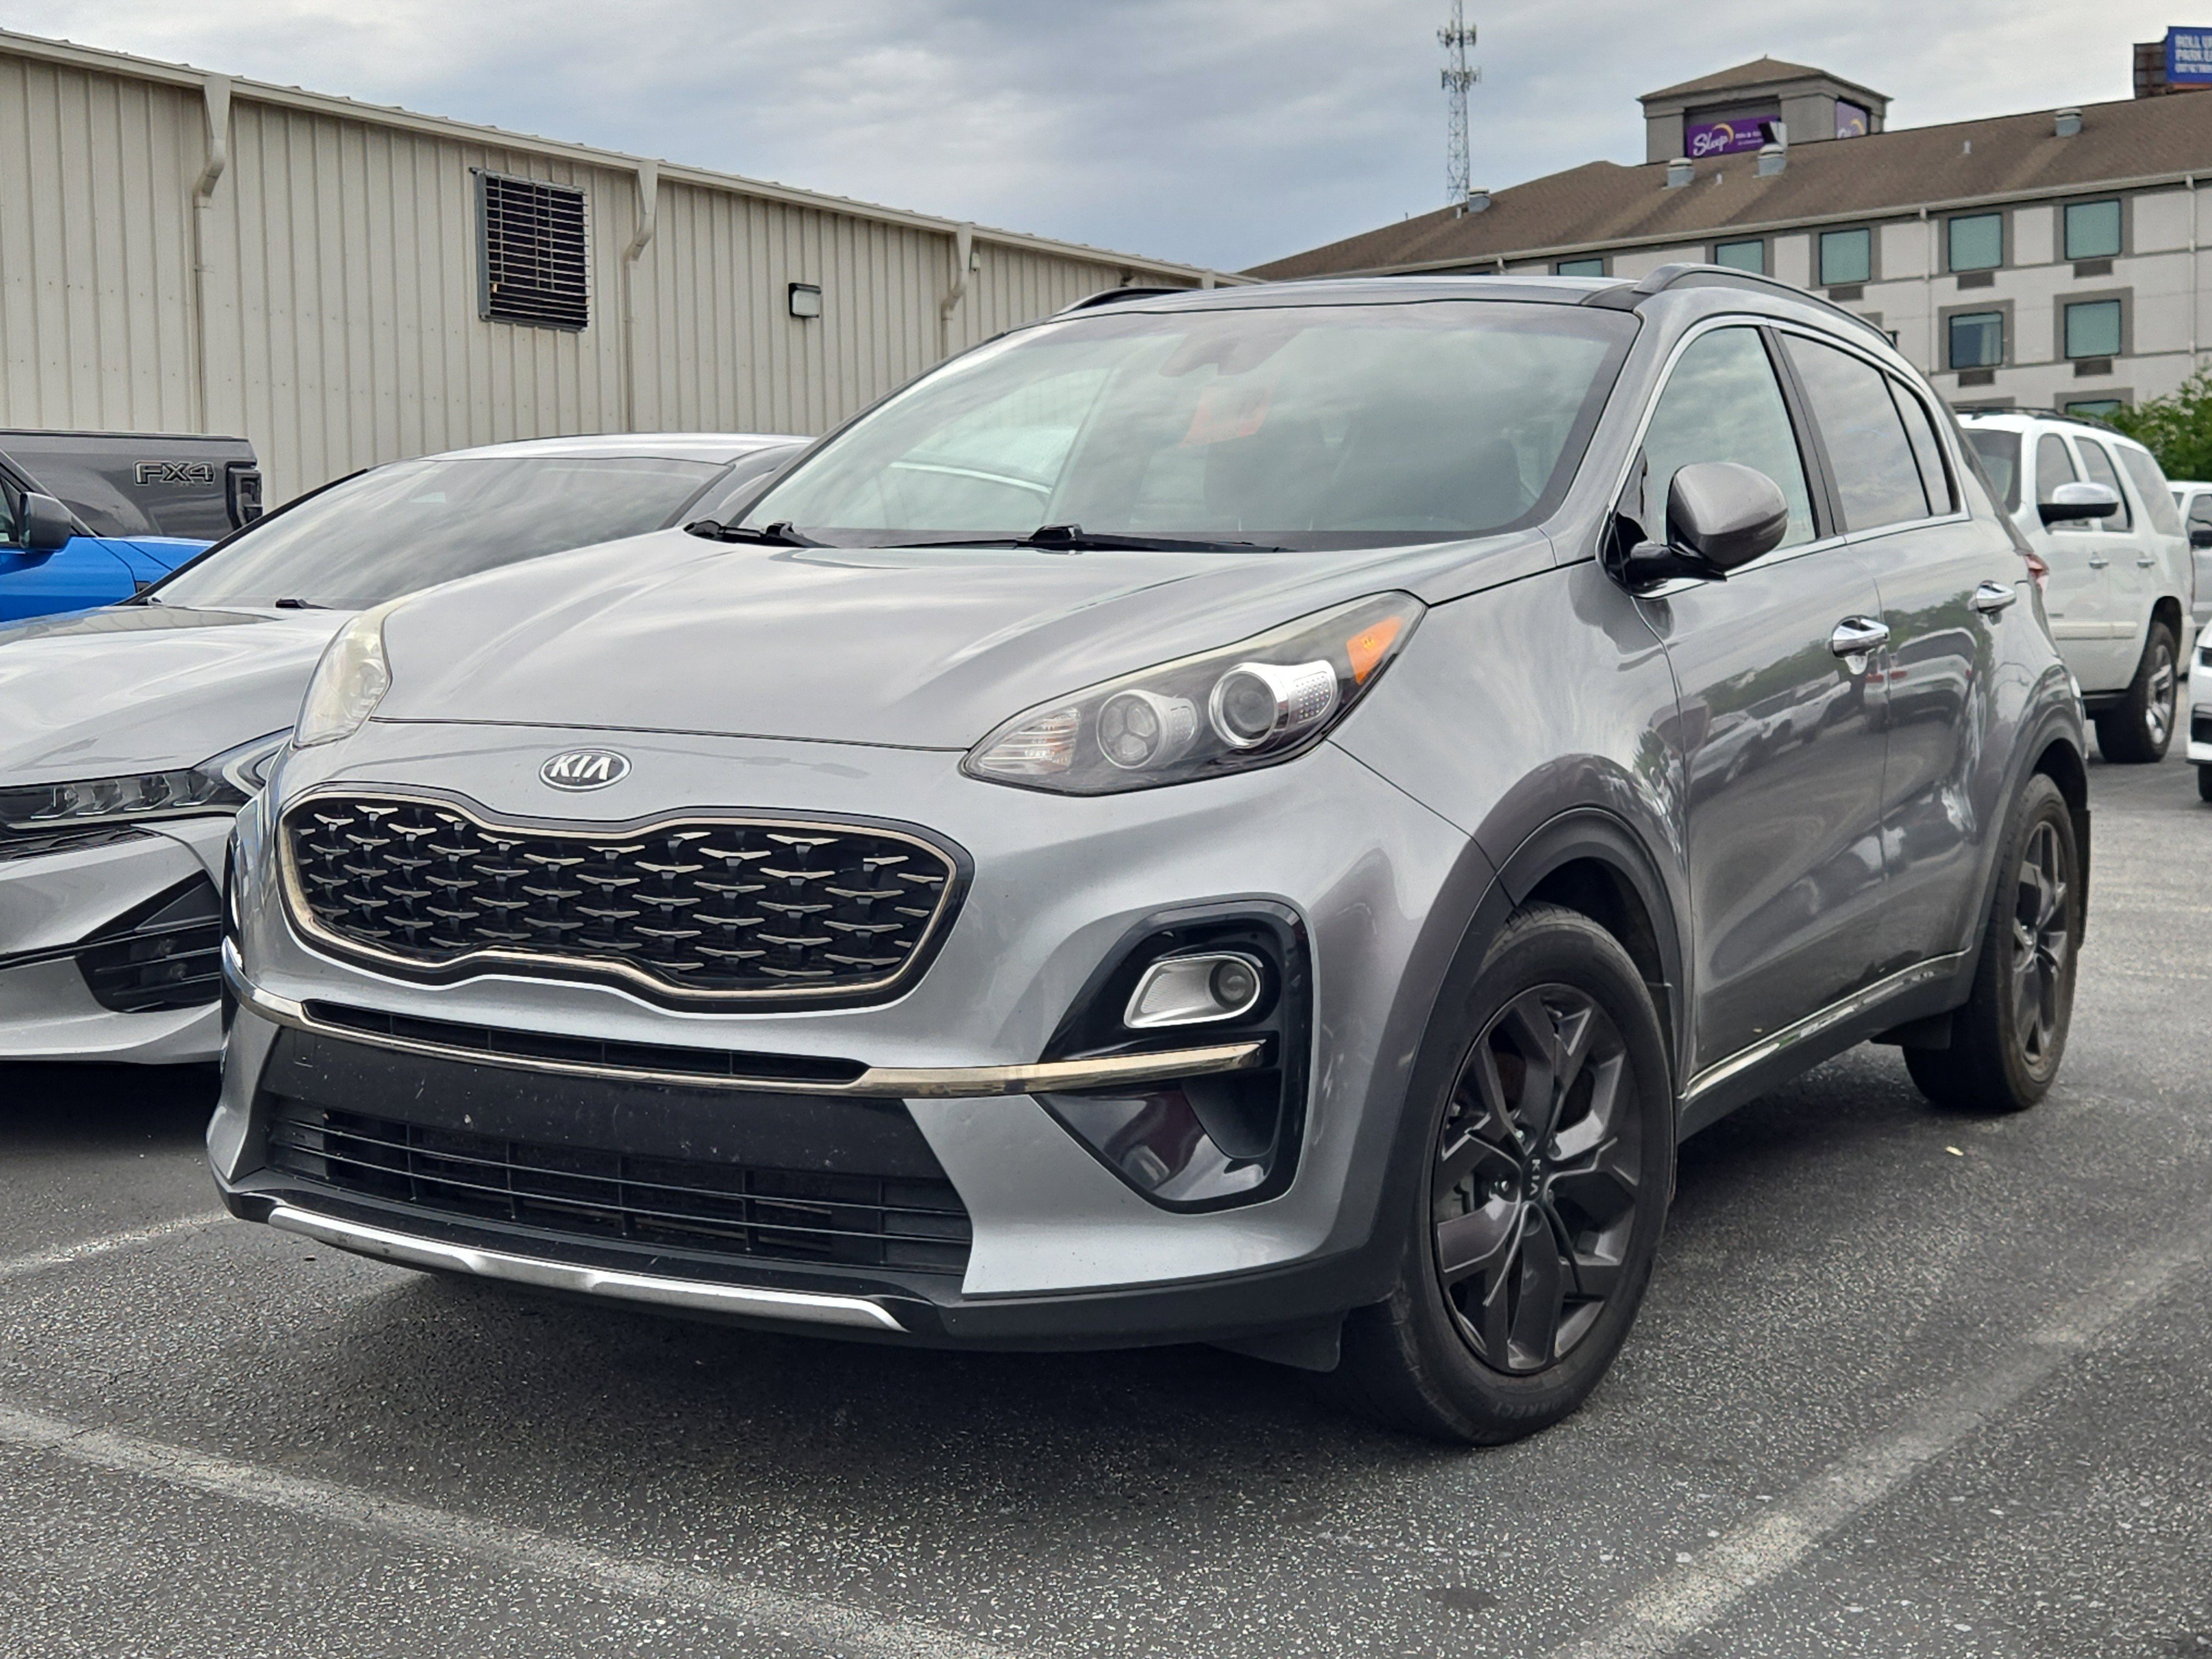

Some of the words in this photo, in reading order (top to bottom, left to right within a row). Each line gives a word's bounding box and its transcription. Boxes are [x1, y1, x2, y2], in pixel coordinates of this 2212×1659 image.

[133, 460, 215, 486] FX4
[549, 754, 612, 780] KIA
[1529, 1158, 1541, 1196] KIA
